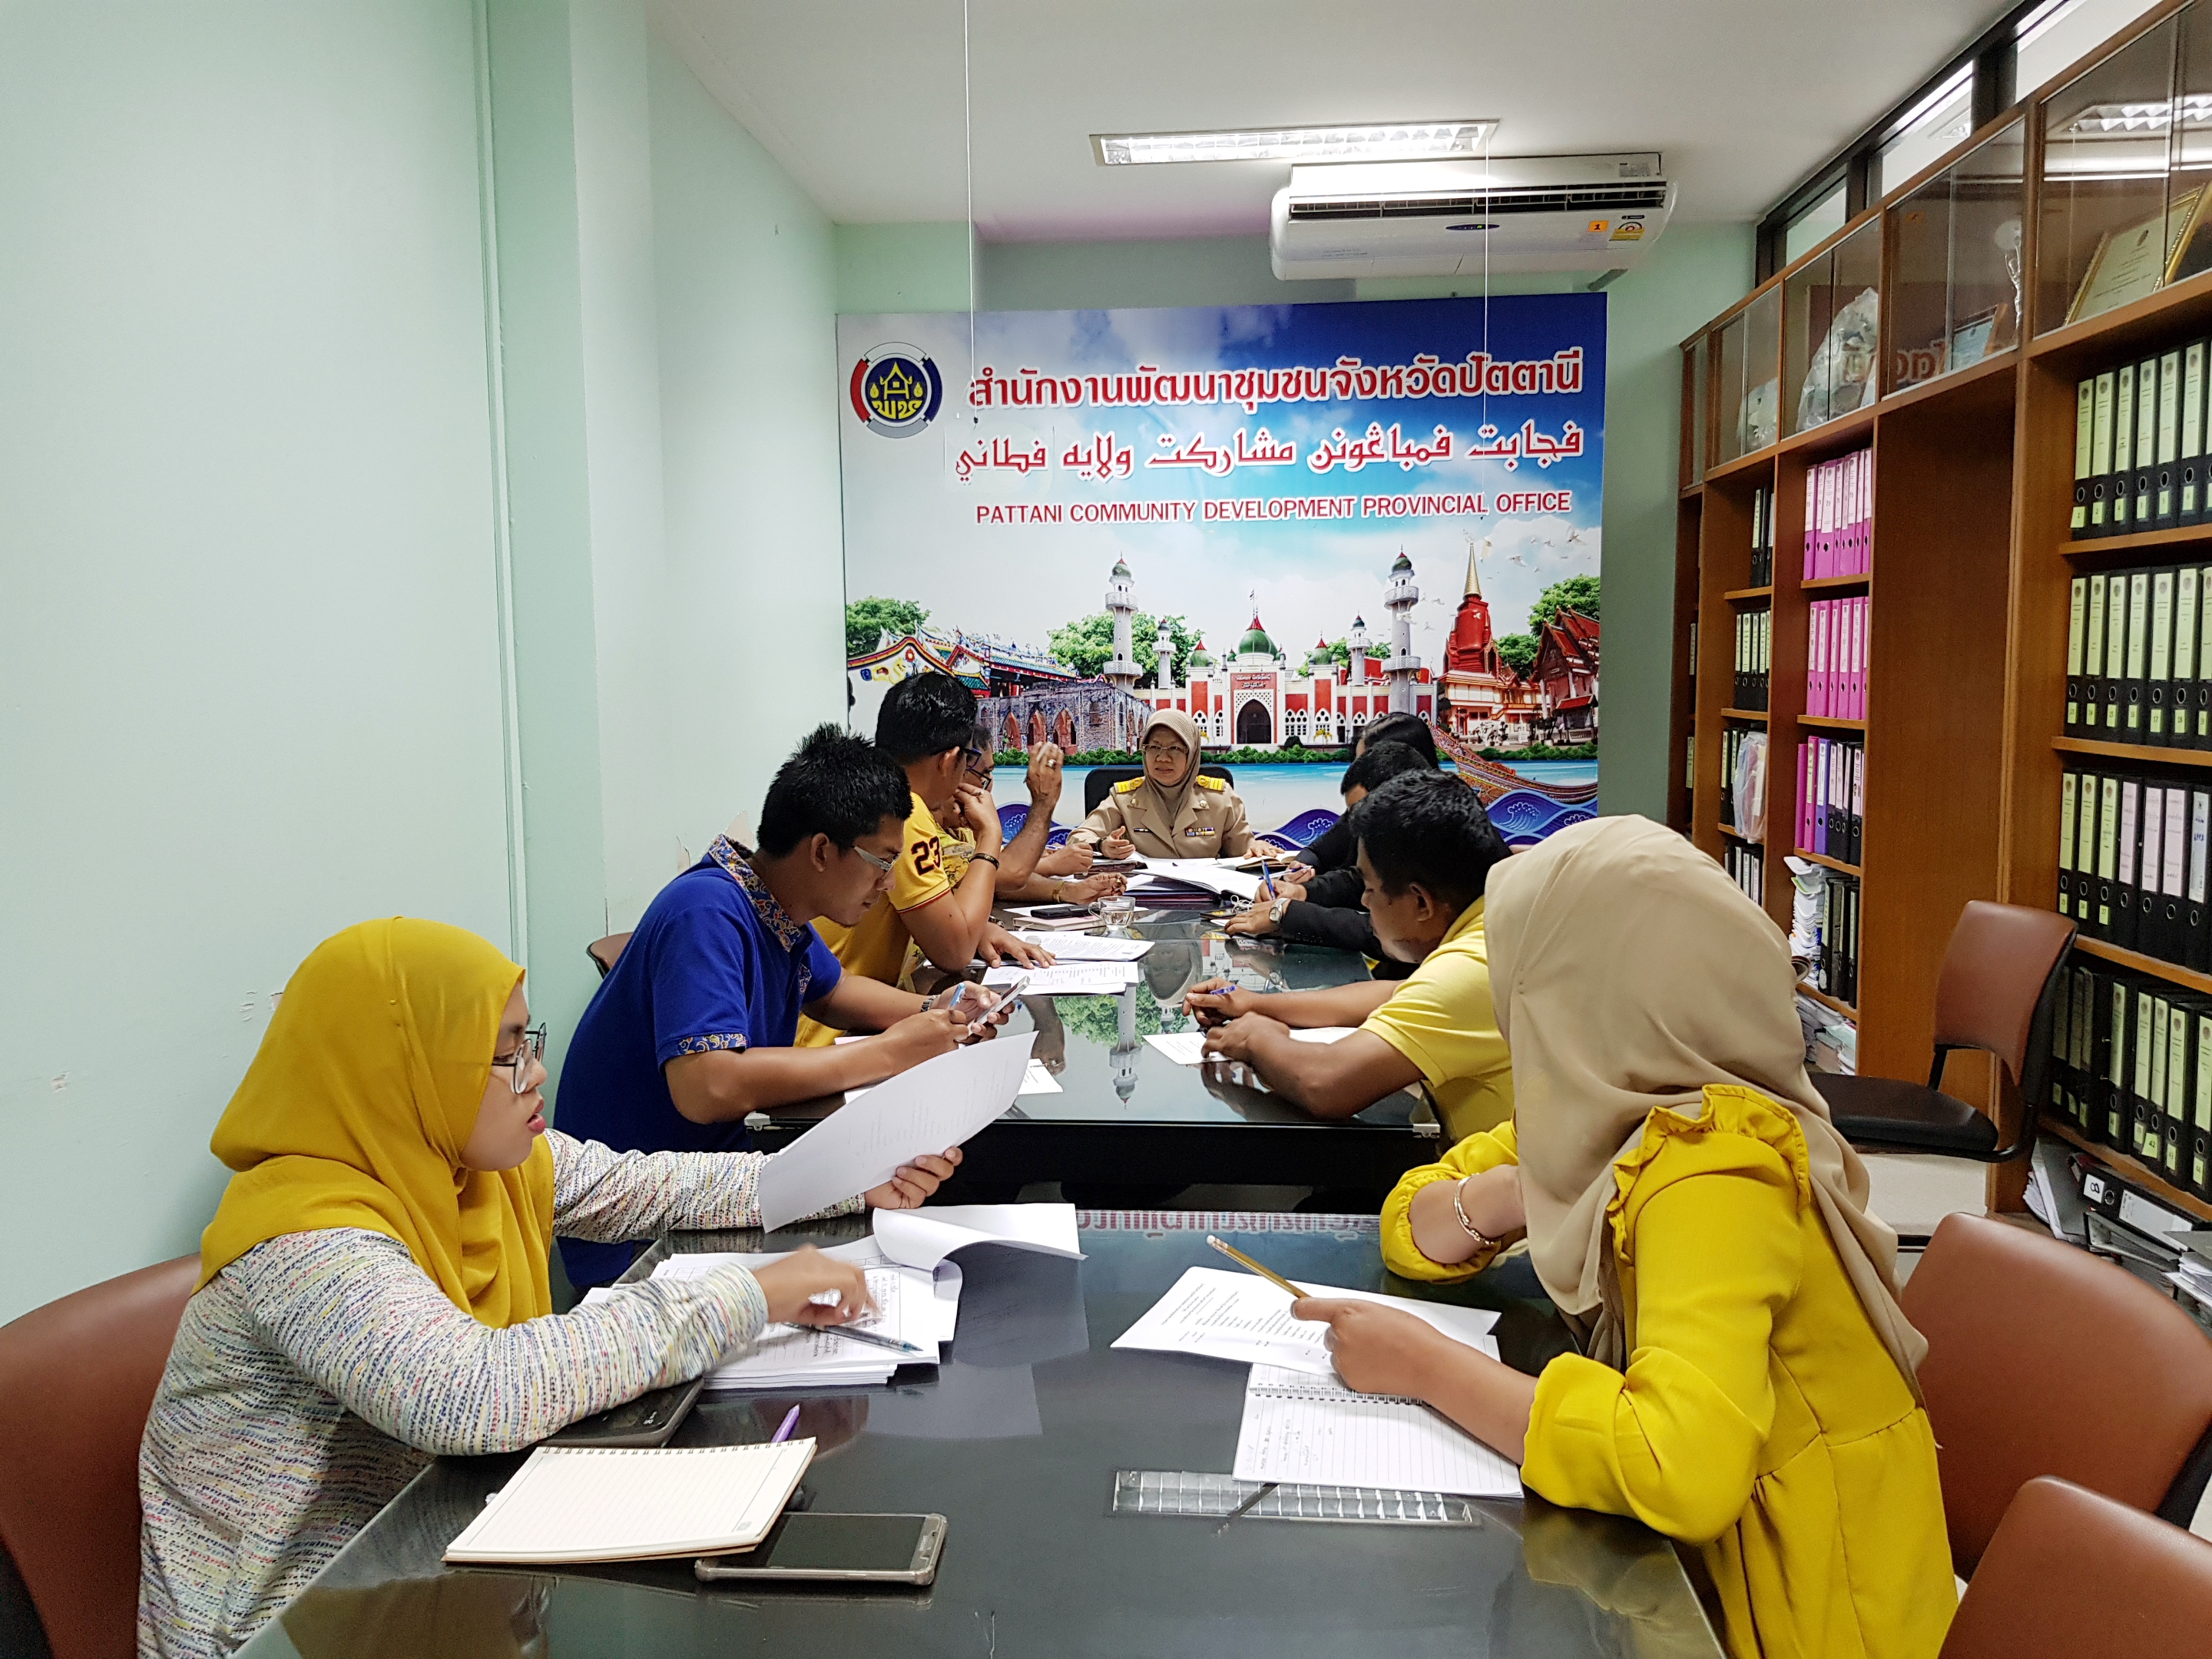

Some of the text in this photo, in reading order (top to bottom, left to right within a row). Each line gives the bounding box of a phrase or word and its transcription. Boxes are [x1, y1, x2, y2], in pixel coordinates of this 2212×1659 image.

[969, 349, 1581, 411] สำนักงานพัฒนาชุมชนจังหวัดปัตตานี
[977, 492, 1571, 523] PATTANI COMMUNITY DEVELOPMENT PROVINCIAL OFFICE
[911, 836, 940, 876] 23
